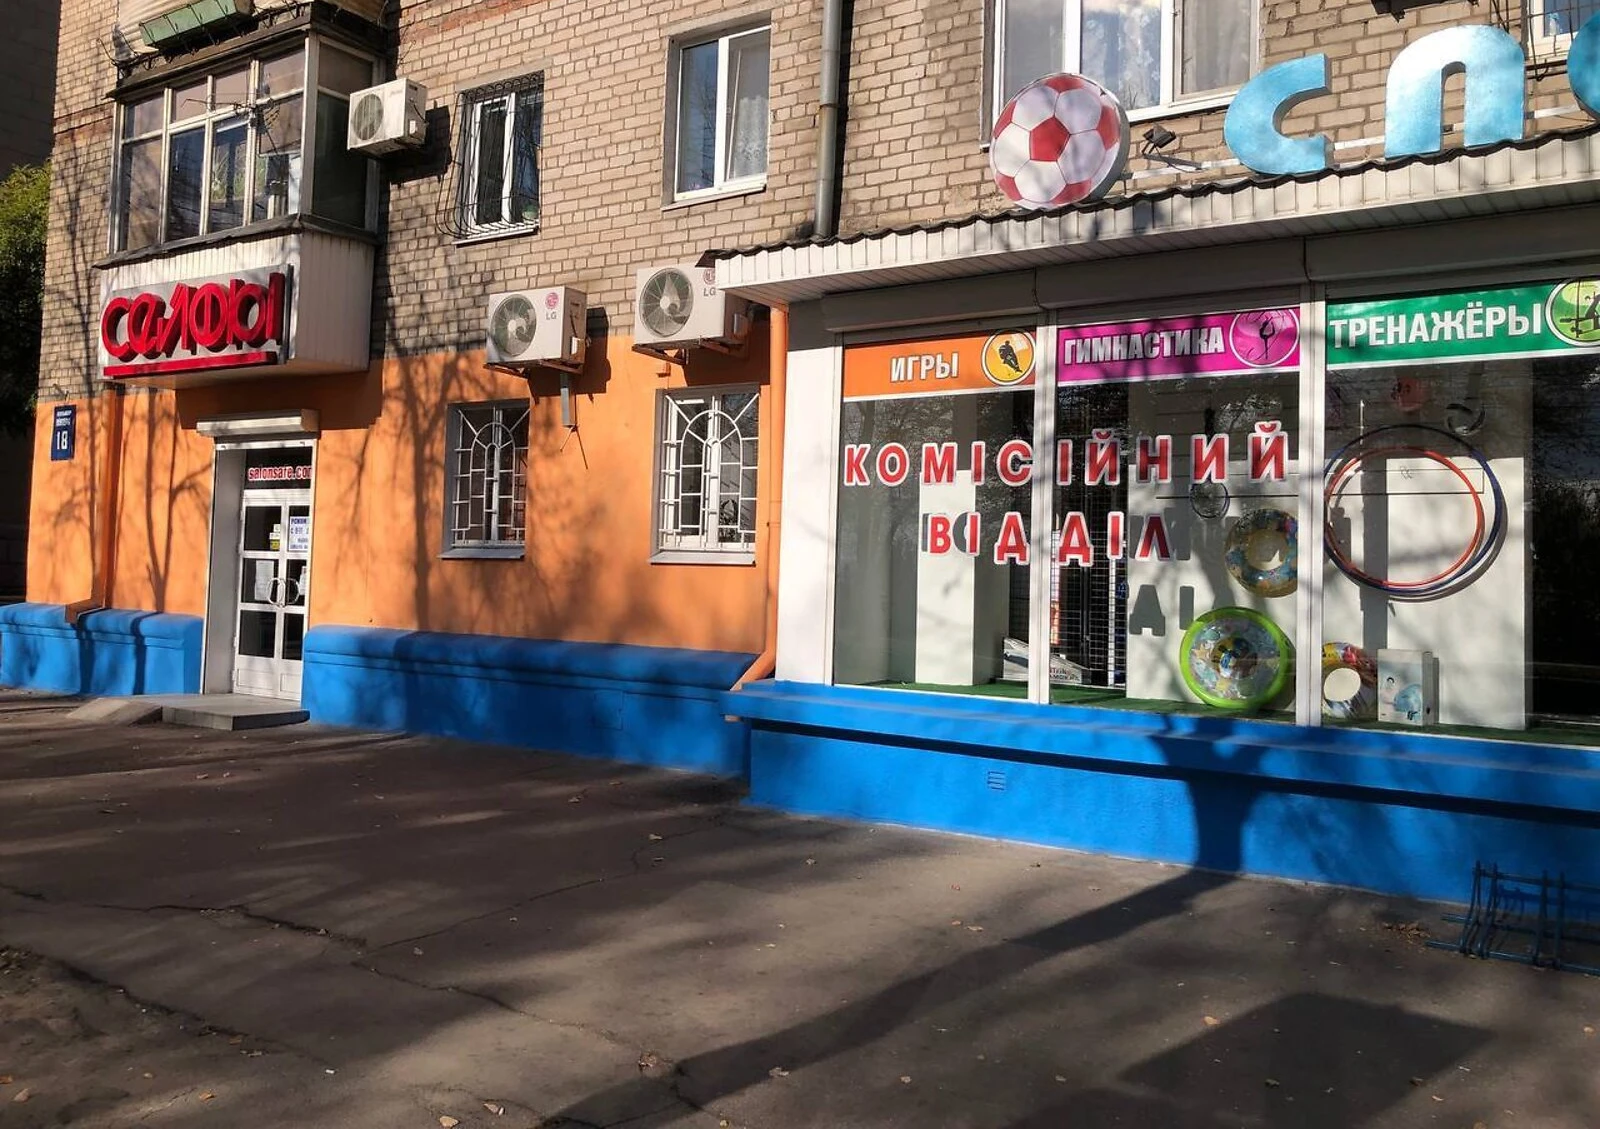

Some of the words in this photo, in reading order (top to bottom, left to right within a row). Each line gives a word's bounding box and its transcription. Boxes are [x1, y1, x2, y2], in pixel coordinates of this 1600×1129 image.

[703, 287, 717, 297] LG
[545, 311, 557, 321] LG
[1329, 301, 1542, 349] ТРЕНАЖЁРЫ
[1064, 325, 1225, 366] ГИМНАСТИКА
[890, 351, 960, 383] ИГРЫ
[56, 431, 68, 450] 18
[842, 420, 1290, 486] КОМІСІЙНИЙ
[927, 511, 1173, 567] ВІДДІЛ
